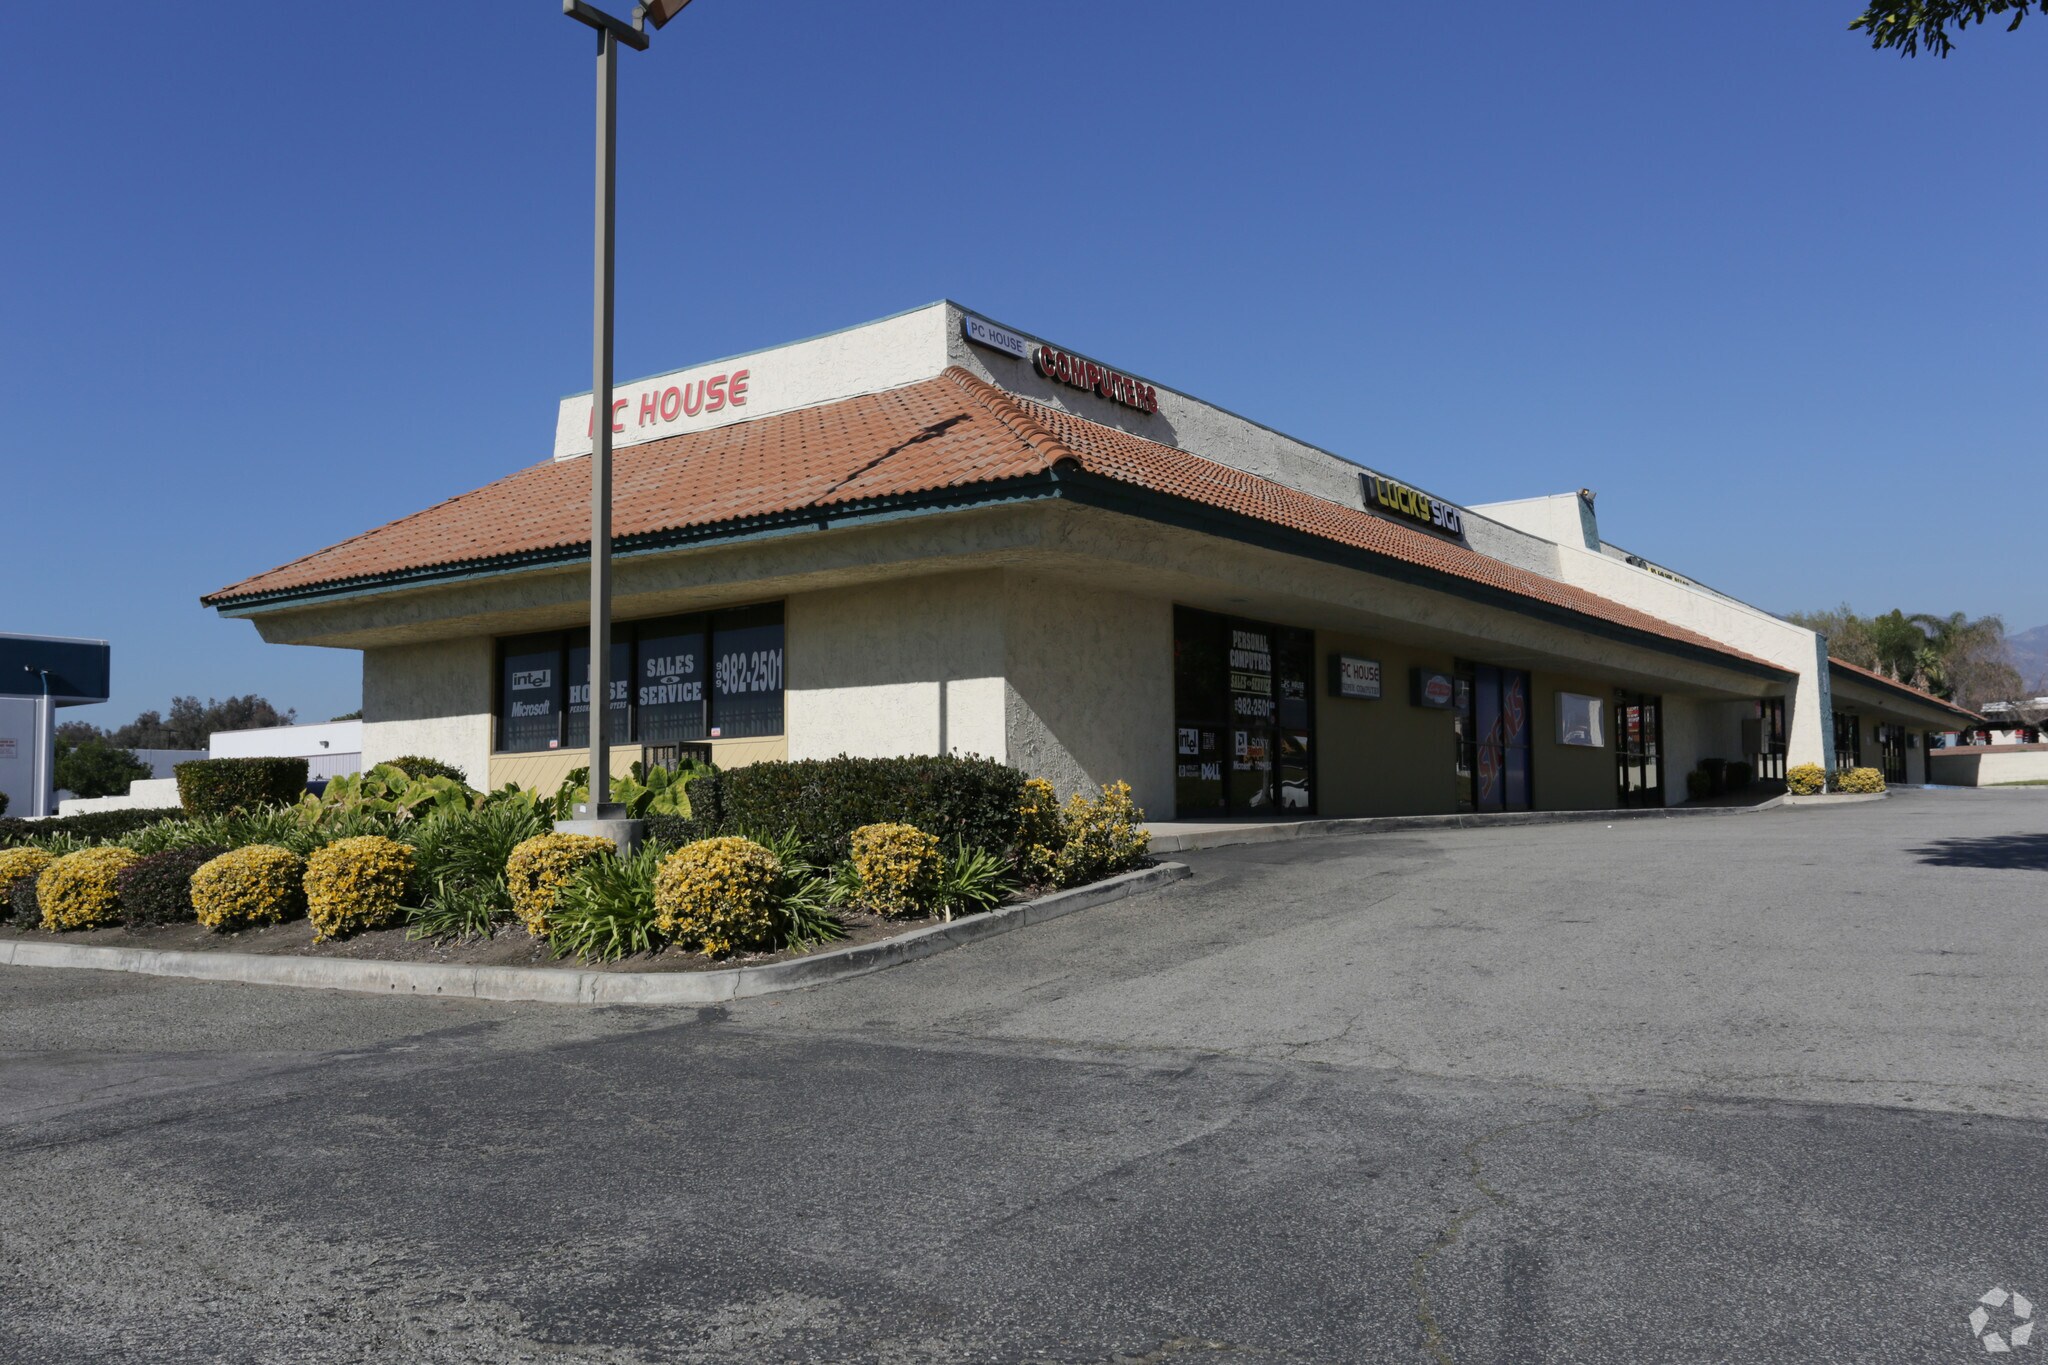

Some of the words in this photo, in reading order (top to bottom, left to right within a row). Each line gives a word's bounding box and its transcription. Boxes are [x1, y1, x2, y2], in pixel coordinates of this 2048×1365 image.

[970, 321, 985, 339] PC
[989, 329, 1023, 353] HOUSE
[1040, 346, 1158, 414] COMPUTERS
[588, 398, 628, 439] C
[638, 369, 750, 428] HOUSE
[1374, 476, 1431, 522] LUCKY
[1232, 630, 1269, 653] PERSONAL
[647, 654, 694, 678] SALES
[722, 648, 783, 695] 982-2501
[1230, 649, 1271, 672] COMPUTERS
[1340, 662, 1351, 678] PC
[1353, 664, 1379, 682] HOUSE
[513, 670, 548, 688] intel
[569, 680, 628, 704] HOSE
[639, 682, 702, 706] SERVICE
[512, 700, 550, 718] Microsoft
[1237, 696, 1270, 717] 982-2501
[1179, 729, 1197, 753] intel
[1201, 762, 1221, 781] DELL
